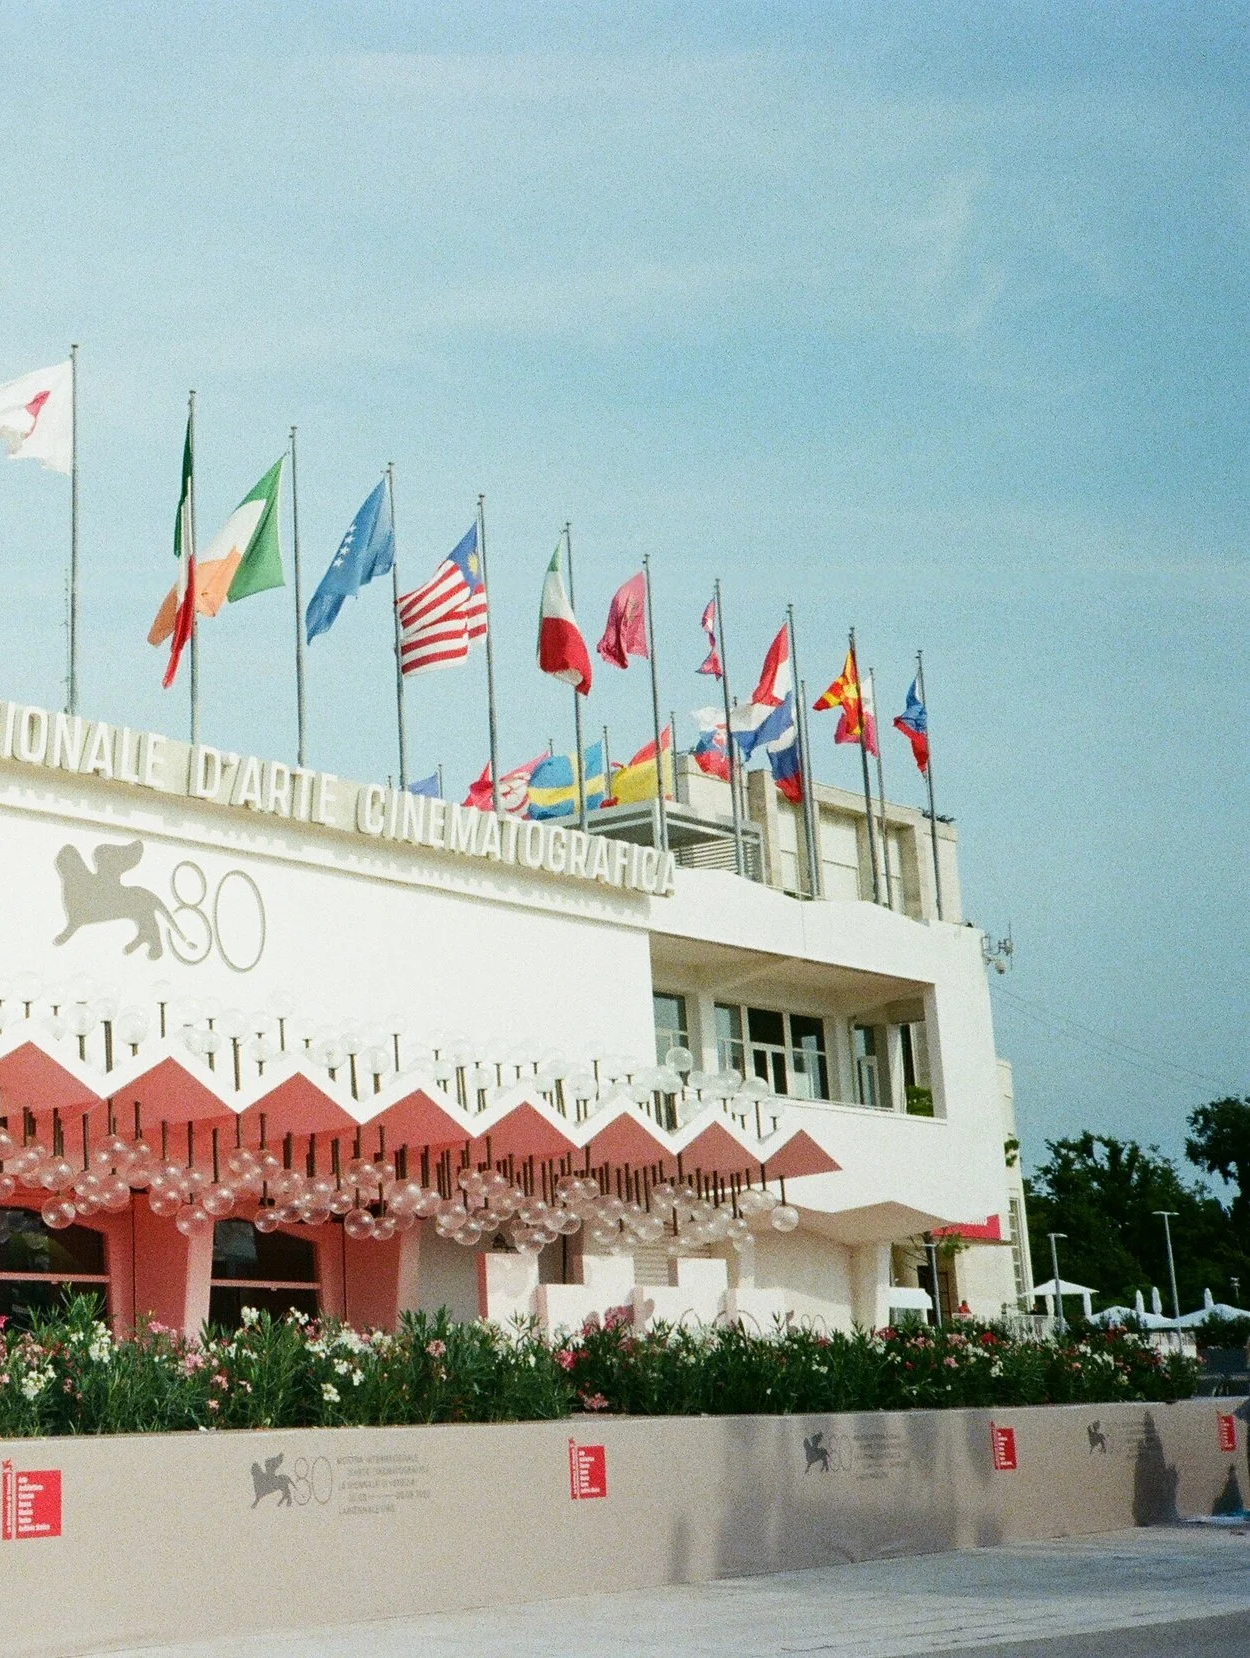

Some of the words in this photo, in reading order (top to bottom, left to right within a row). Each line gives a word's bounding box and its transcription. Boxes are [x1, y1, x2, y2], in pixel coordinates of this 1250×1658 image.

[190, 744, 338, 825] D'ARTE
[358, 783, 676, 896] CINEMATOGRAFICA
[166, 860, 266, 973] 80
